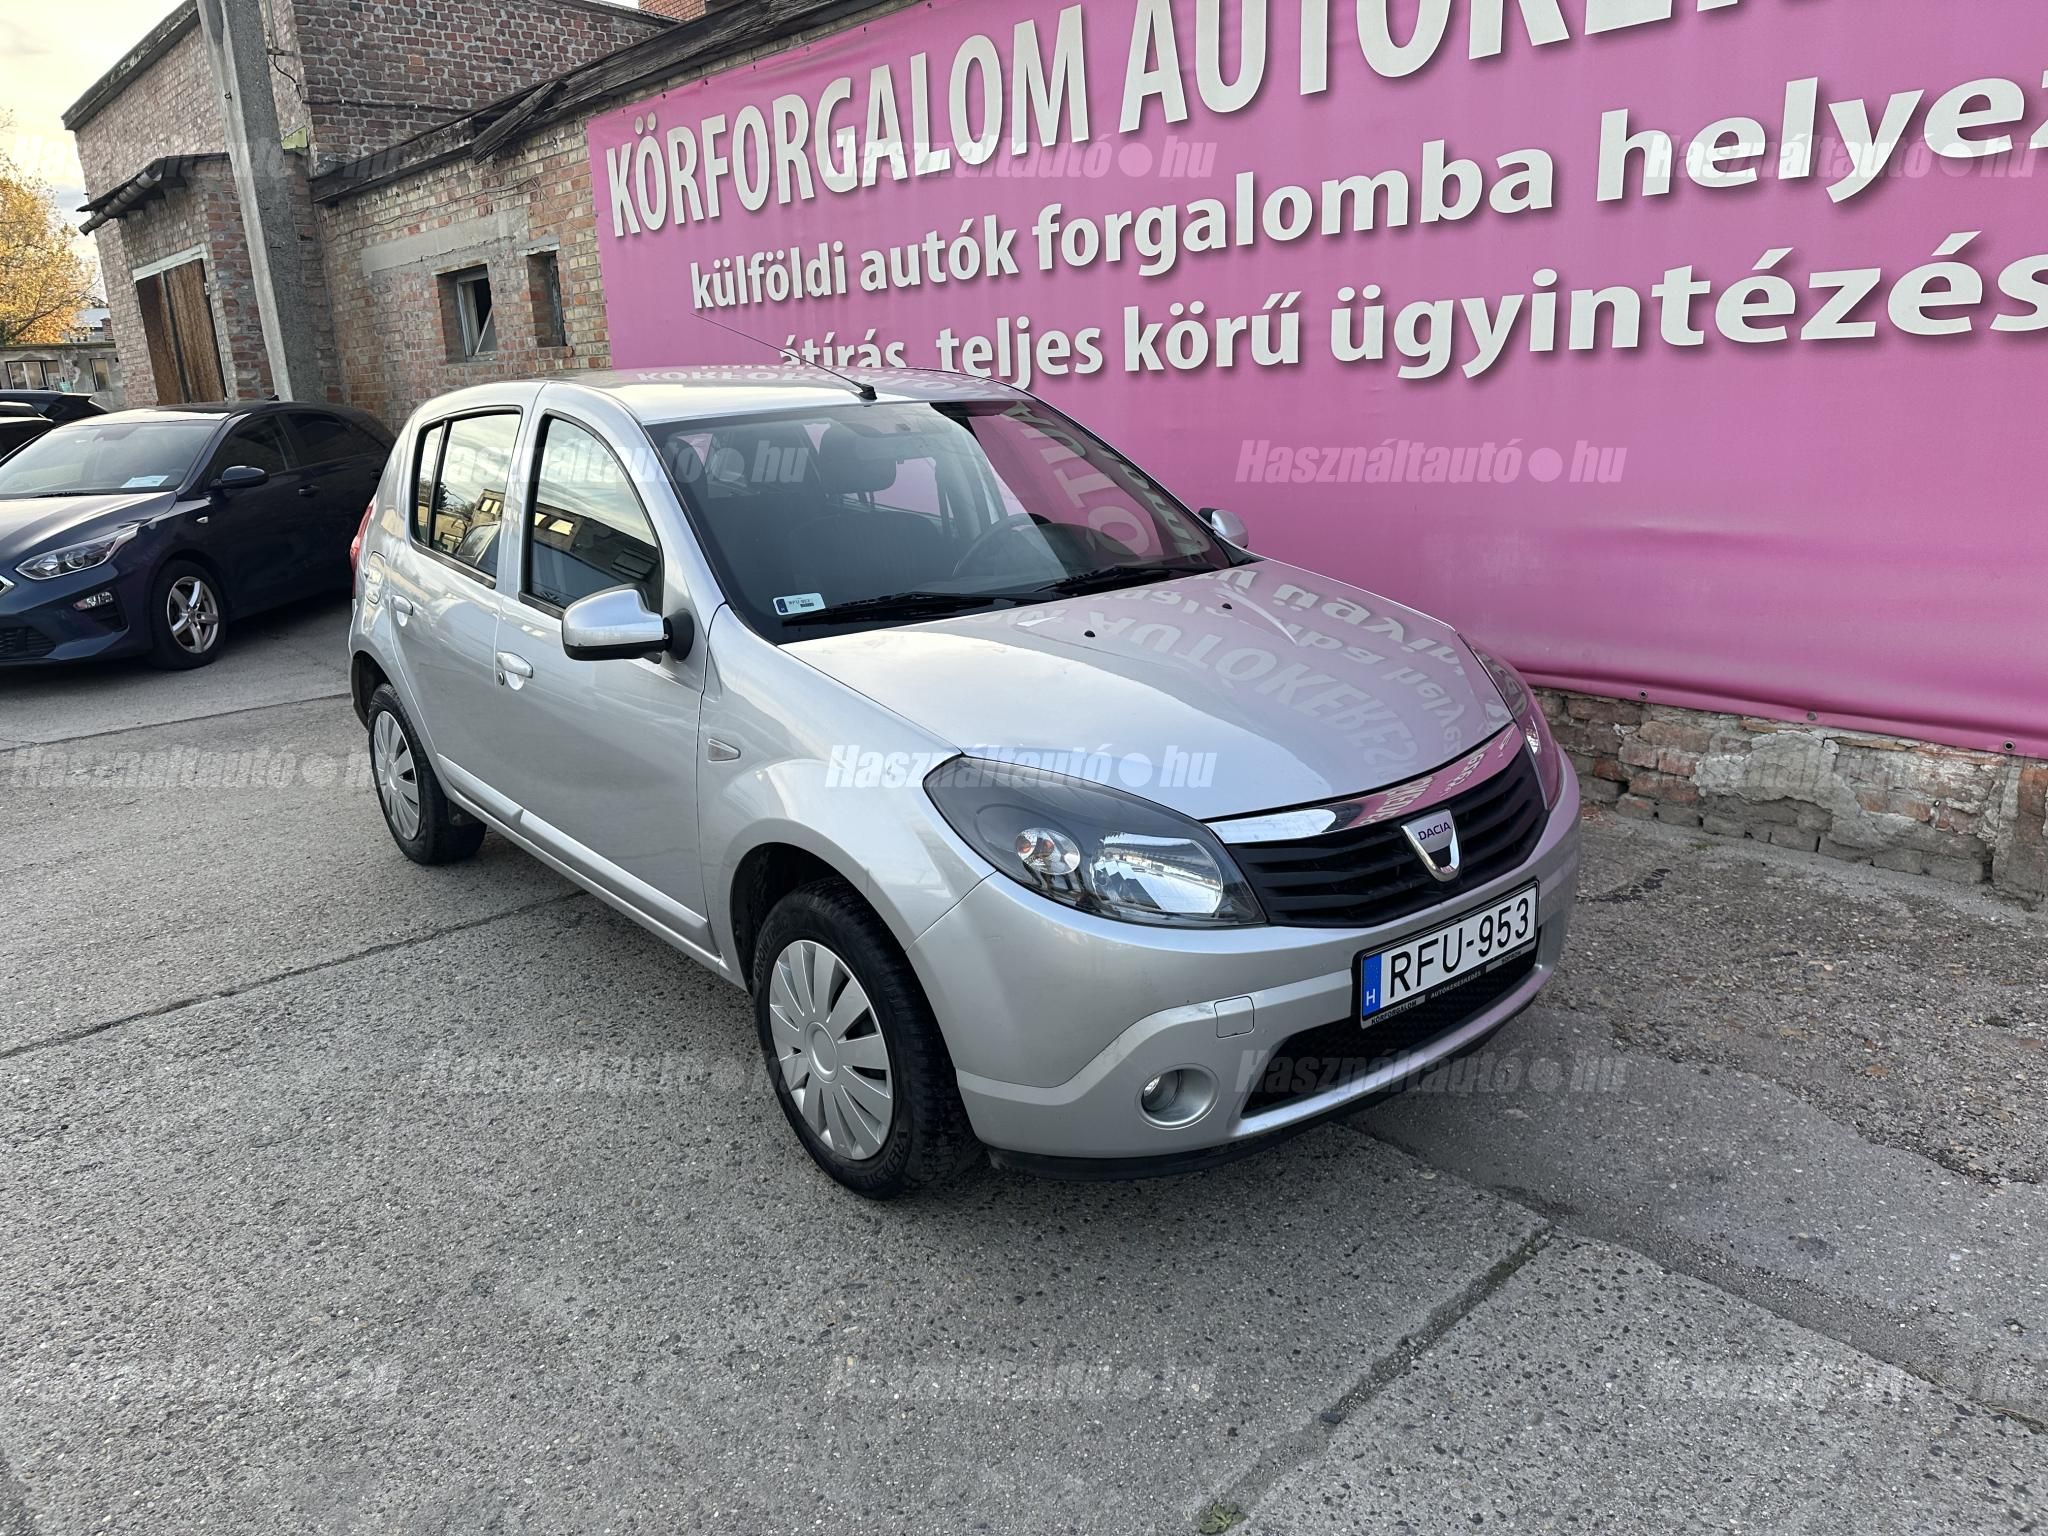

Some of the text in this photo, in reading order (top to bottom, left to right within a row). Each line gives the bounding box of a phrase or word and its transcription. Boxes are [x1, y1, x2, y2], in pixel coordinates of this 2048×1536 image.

[606, 4, 1090, 238] KÖRFORGALOM
[690, 70, 2048, 310] külföldi autók forgalomba helye
[936, 316, 1103, 389] teljes
[1123, 291, 1302, 374] körű
[1330, 231, 2048, 380] ügyintézés
[1417, 819, 1452, 842] DACIA
[1365, 897, 1529, 1007] H RFU-953
